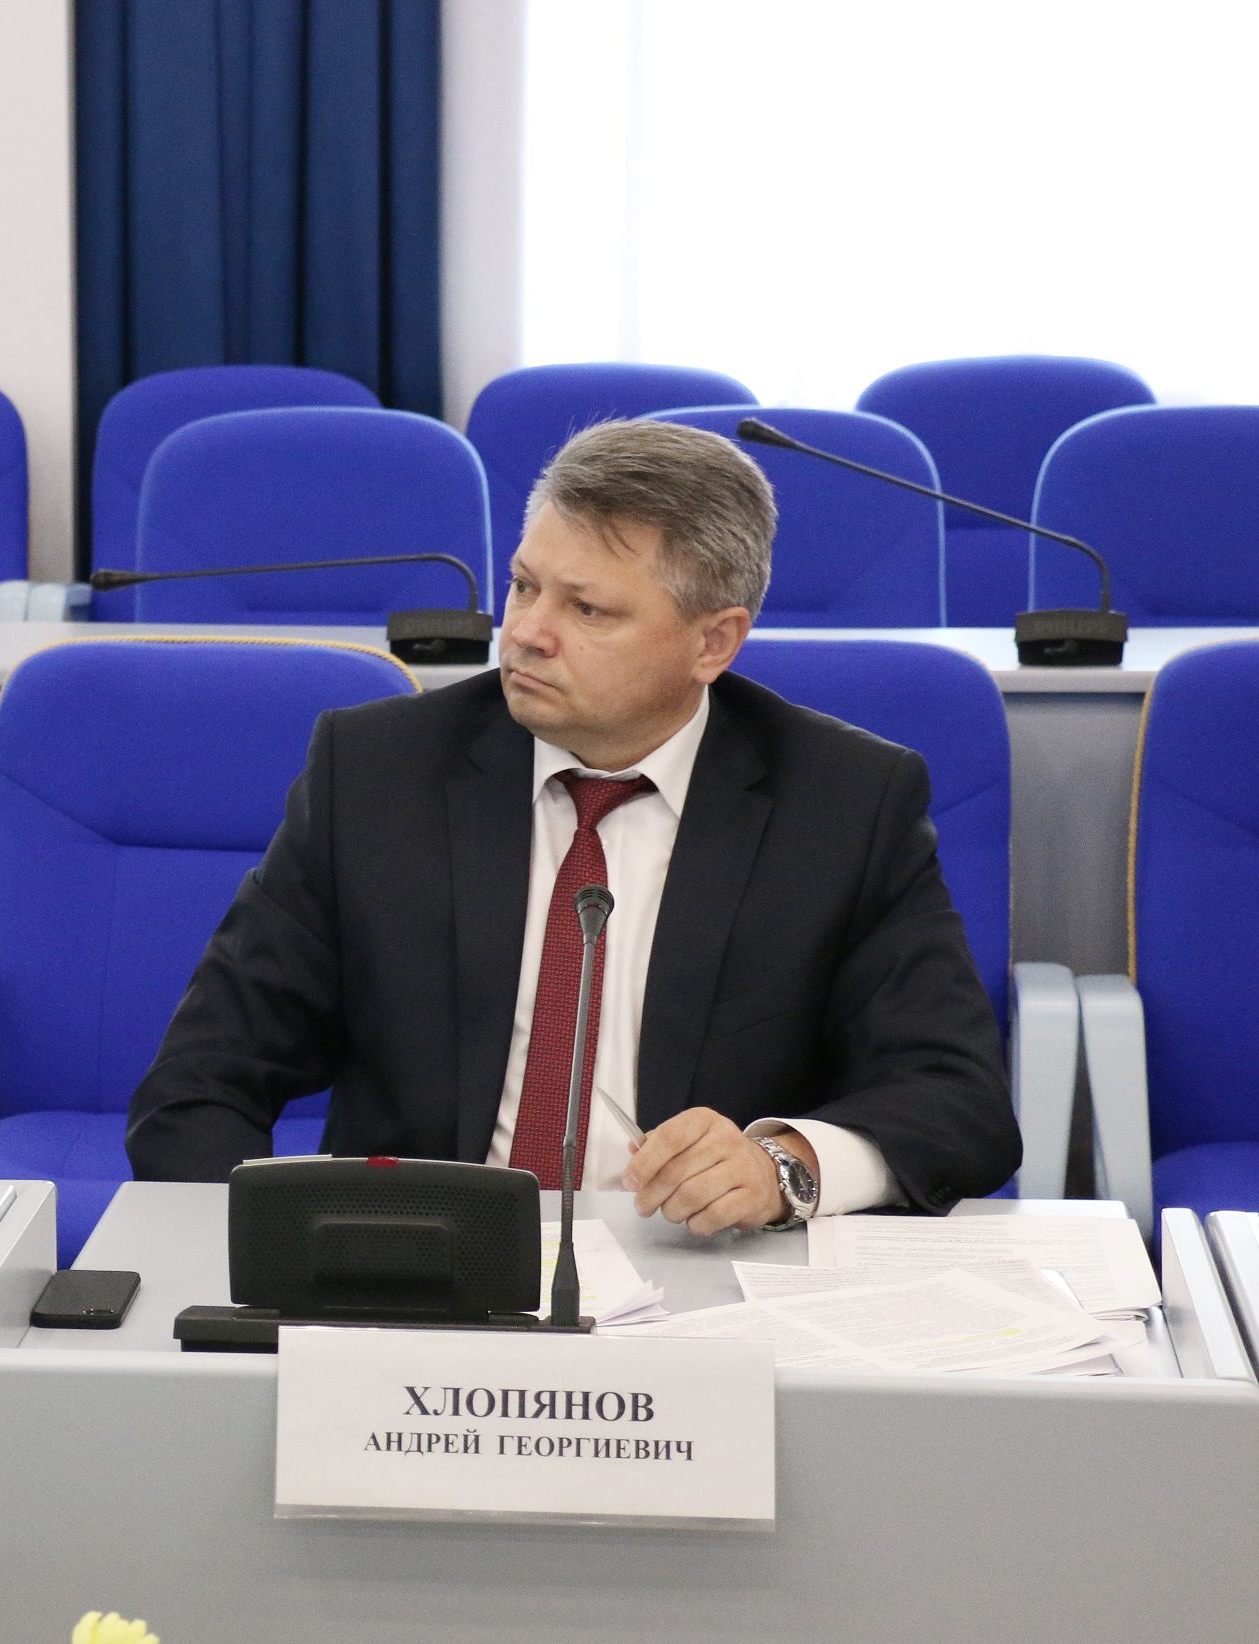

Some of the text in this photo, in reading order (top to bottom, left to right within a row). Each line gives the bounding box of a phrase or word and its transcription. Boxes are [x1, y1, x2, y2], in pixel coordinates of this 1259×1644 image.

[403, 1385, 656, 1423] ХЛОПЯНОВ
[363, 1428, 695, 1462] АНДРЕЙ ГЕОРГИЕВИЧ
